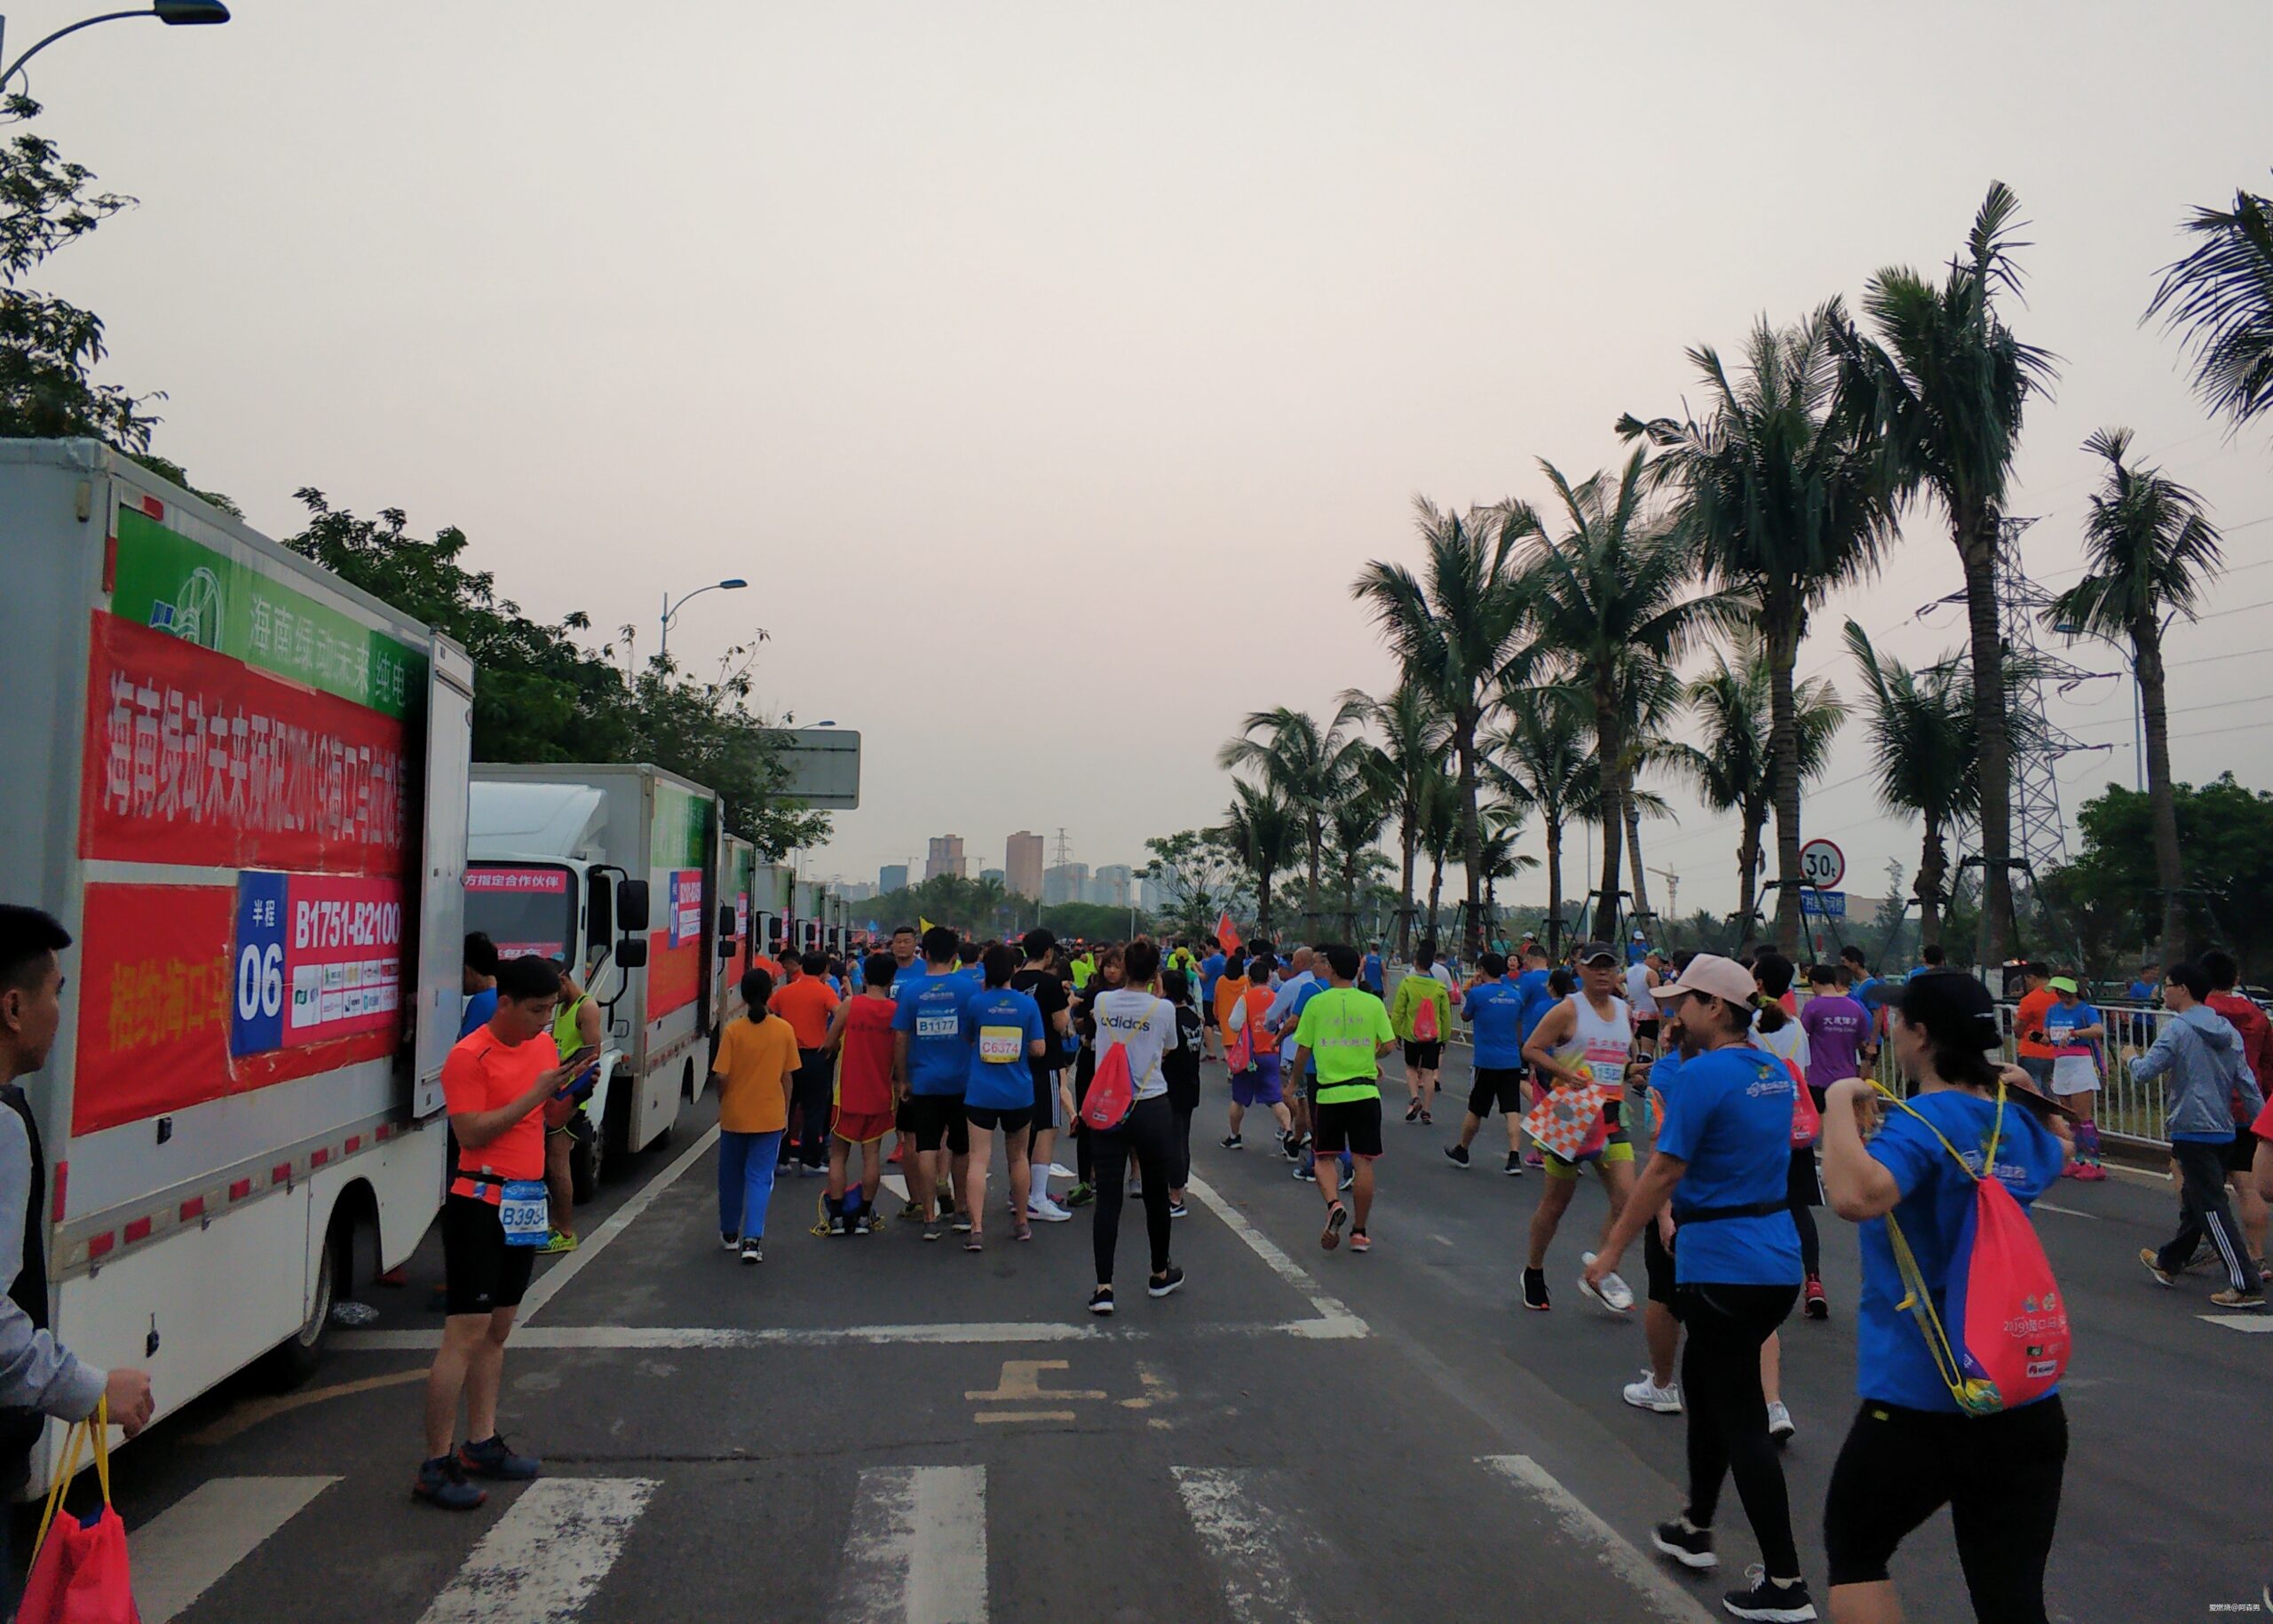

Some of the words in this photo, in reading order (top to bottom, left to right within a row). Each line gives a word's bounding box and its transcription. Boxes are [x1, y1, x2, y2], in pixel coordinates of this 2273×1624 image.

[376, 650, 408, 708] 纯电
[252, 899, 275, 928] 半程
[296, 900, 400, 949] B1751-B2100
[238, 942, 283, 1021] 06
[919, 1020, 954, 1032] B1177
[1100, 1015, 1151, 1032] adidas
